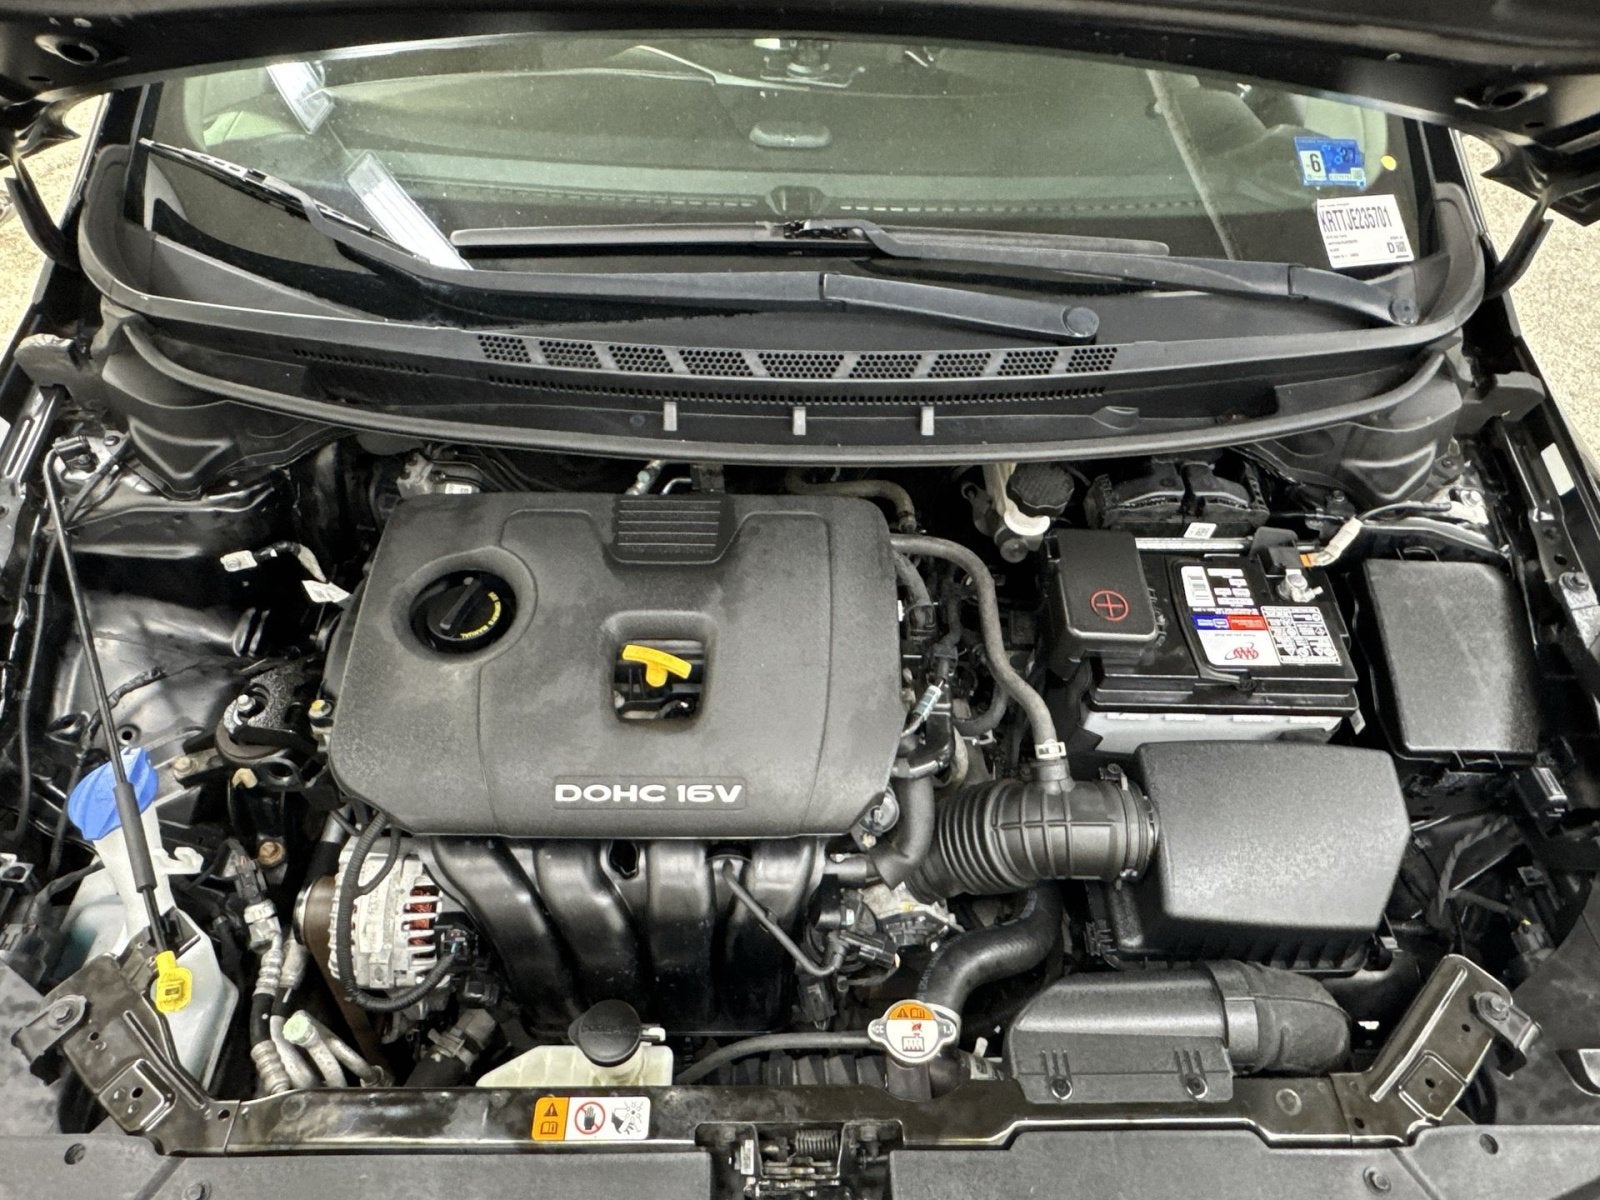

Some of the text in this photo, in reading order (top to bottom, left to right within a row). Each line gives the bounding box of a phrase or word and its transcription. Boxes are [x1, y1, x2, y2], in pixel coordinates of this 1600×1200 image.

[1309, 153, 1321, 173] 6
[1387, 242, 1396, 253] D
[554, 784, 742, 802] DOHC 16V
